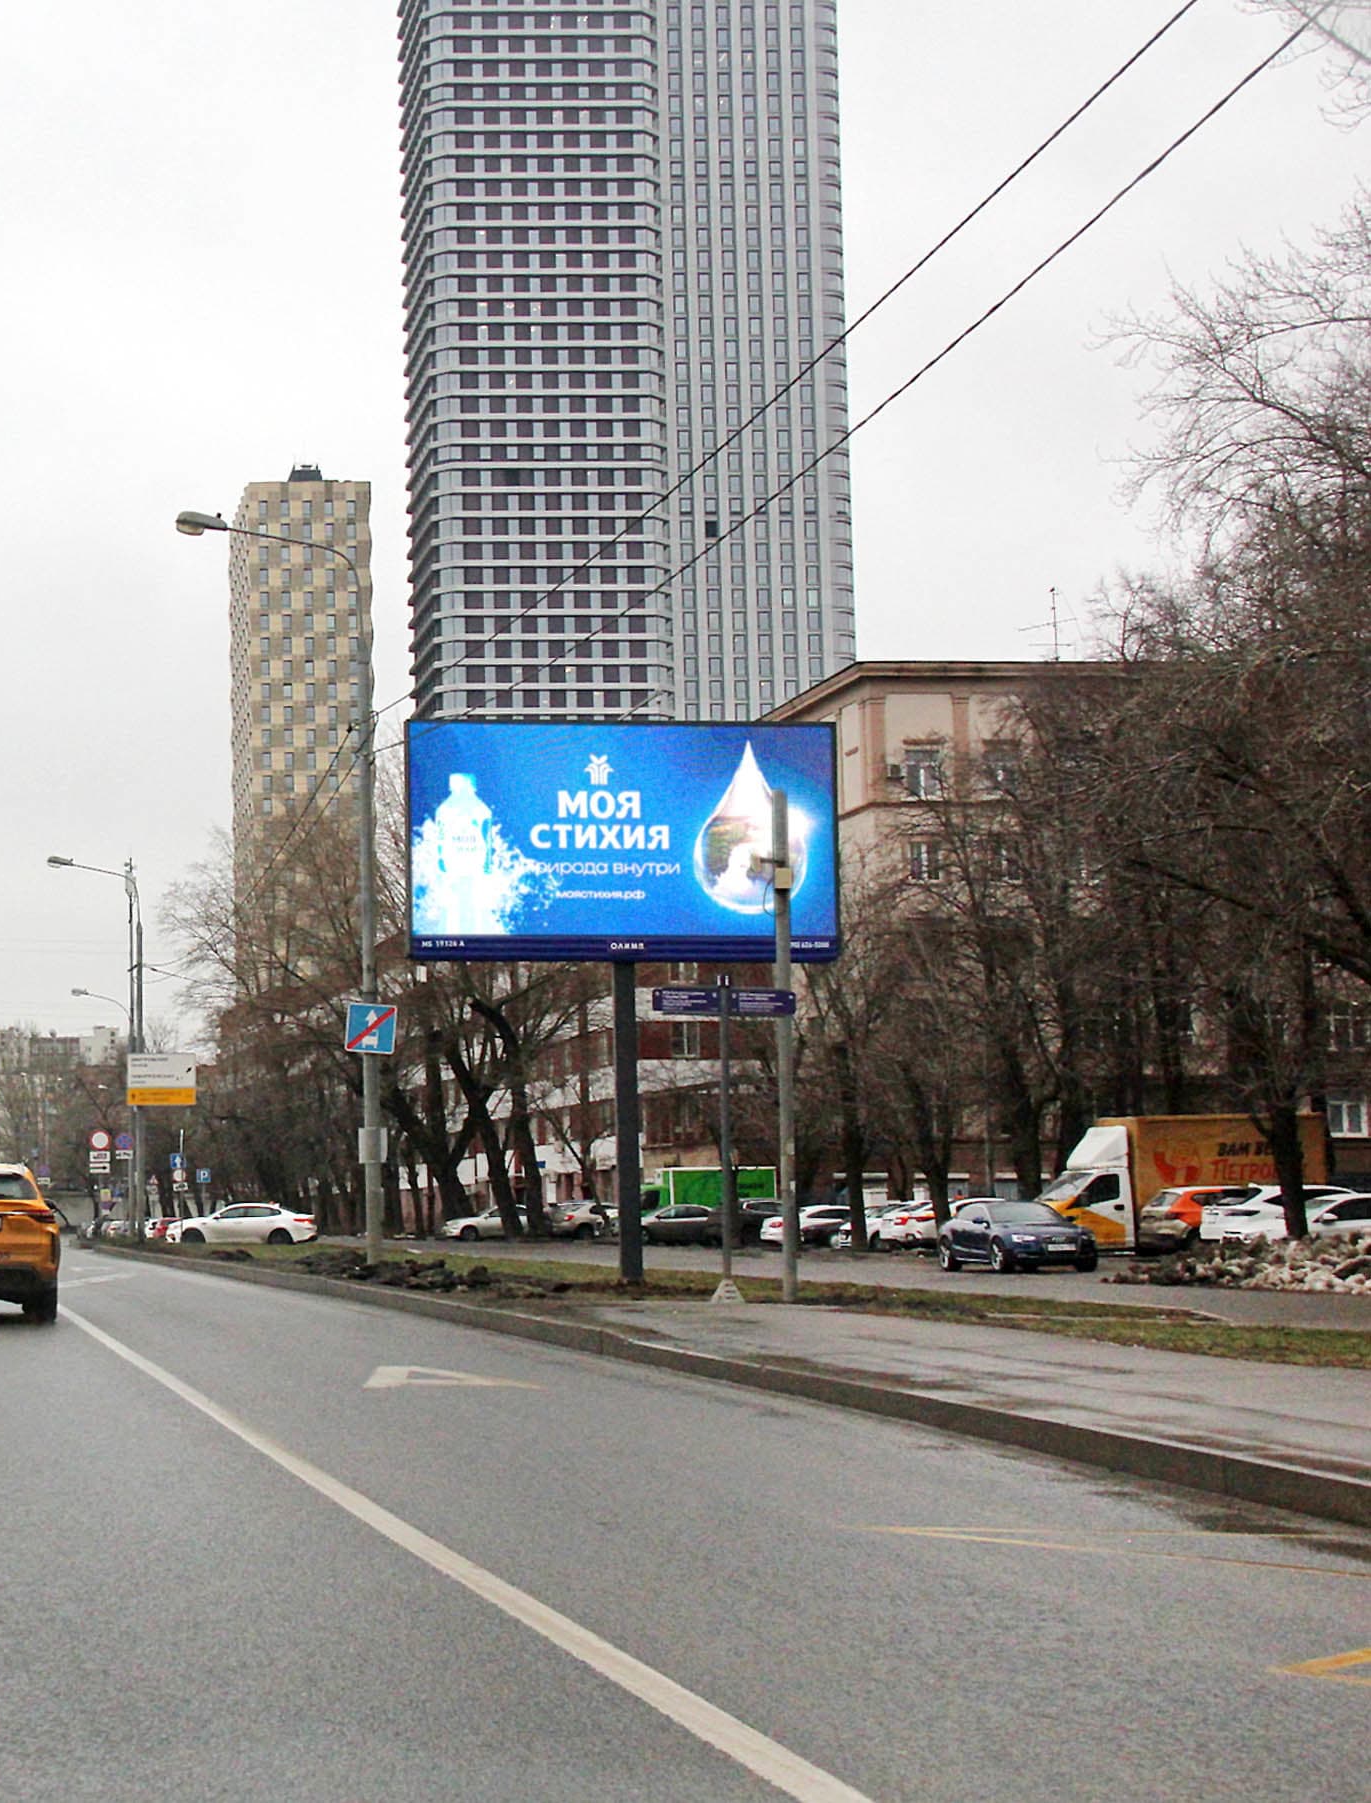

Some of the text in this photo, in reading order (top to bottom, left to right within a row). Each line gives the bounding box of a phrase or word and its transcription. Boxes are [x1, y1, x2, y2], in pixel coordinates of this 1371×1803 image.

[557, 790, 641, 819] МОЯ
[529, 823, 670, 850] СТИХИЯ
[612, 861, 681, 877] внутри
[556, 889, 646, 900] моястихия.рф
[1210, 1159, 1280, 1181] ПЕТРО
